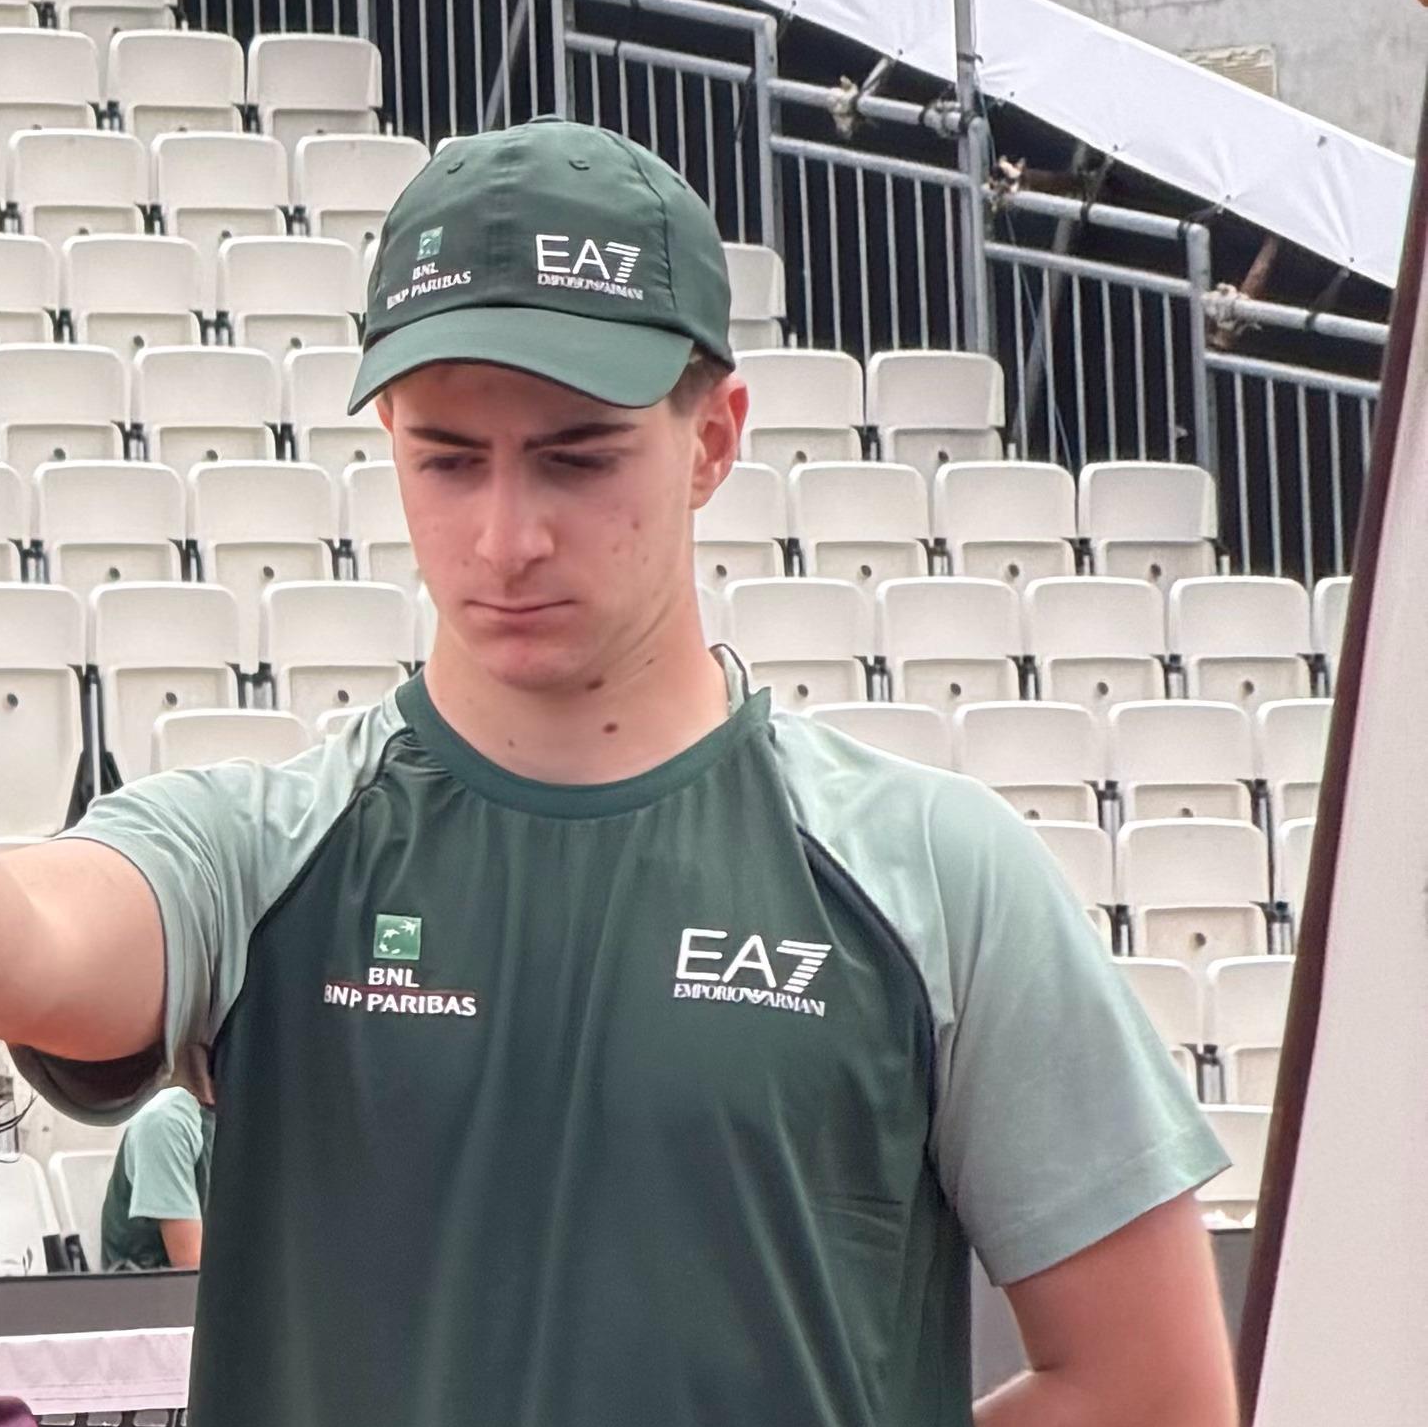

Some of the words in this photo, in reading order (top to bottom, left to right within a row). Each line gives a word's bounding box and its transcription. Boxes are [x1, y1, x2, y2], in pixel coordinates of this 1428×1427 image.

[535, 233, 642, 284] EA7
[367, 966, 421, 988] BNL
[675, 927, 833, 994] EA7
[323, 983, 363, 1008] BNP
[366, 992, 477, 1017] PARIBAS
[673, 982, 746, 1003] EMPORIO
[760, 990, 826, 1018] ARMAN
